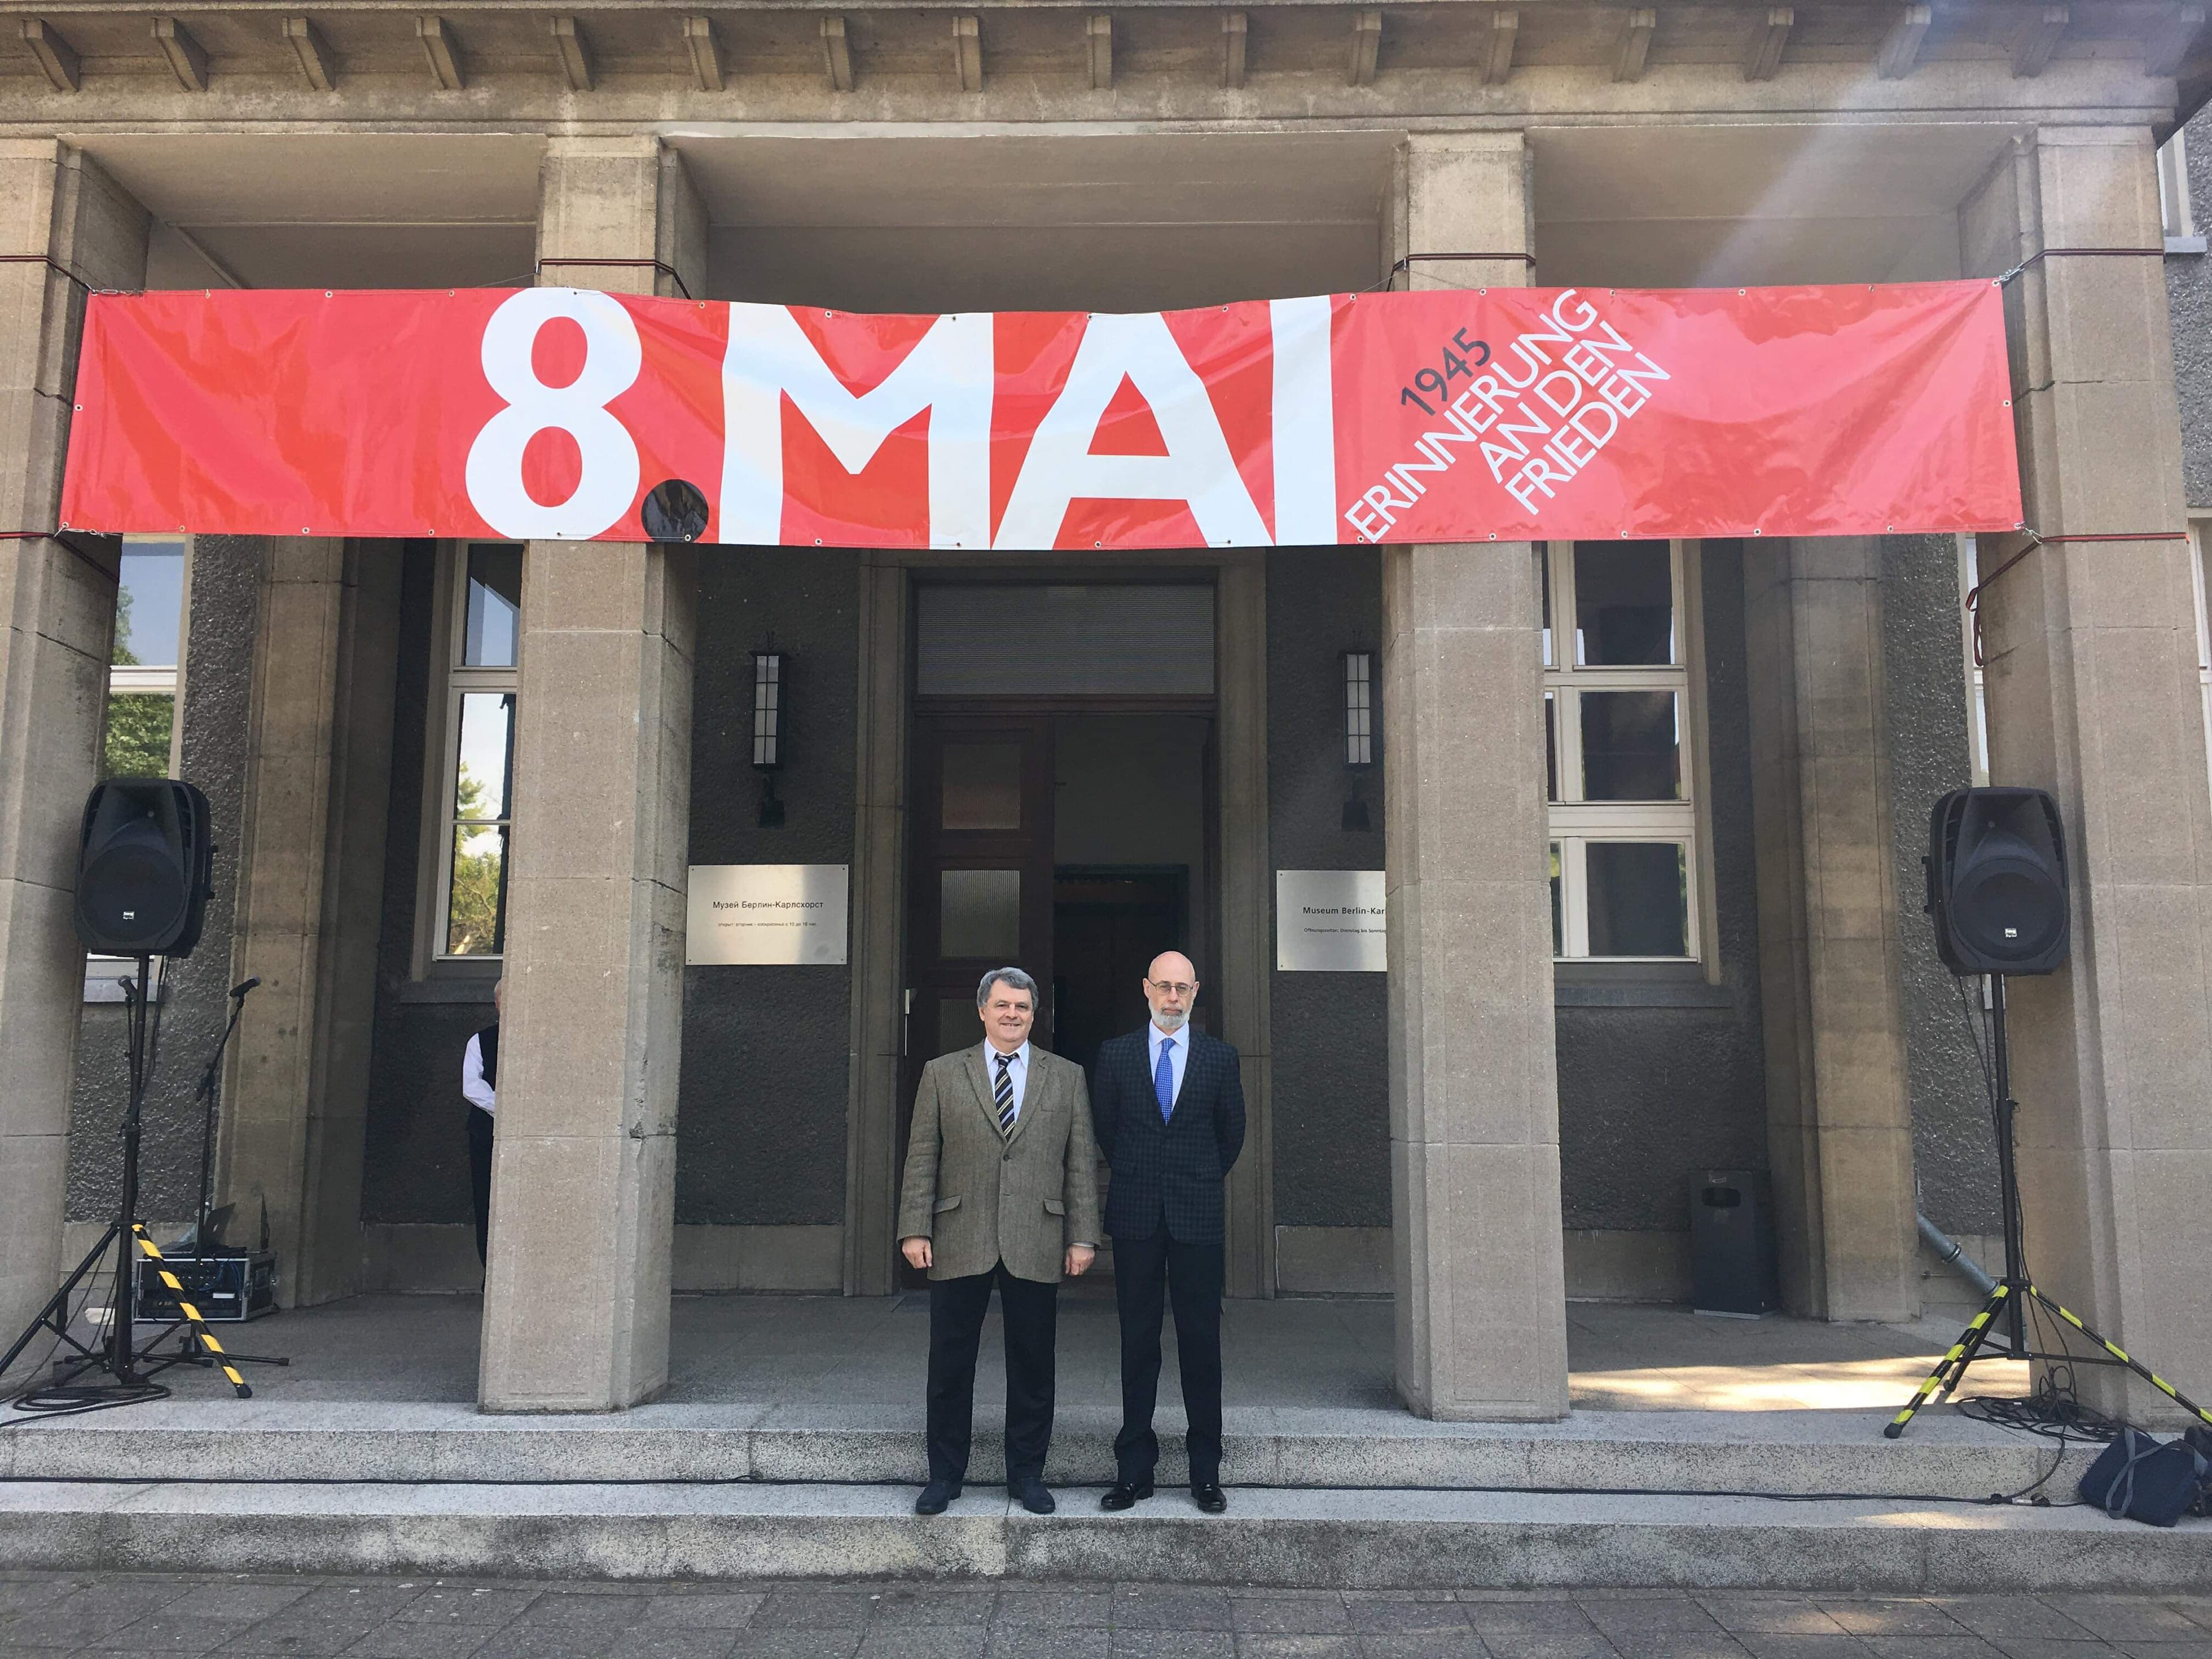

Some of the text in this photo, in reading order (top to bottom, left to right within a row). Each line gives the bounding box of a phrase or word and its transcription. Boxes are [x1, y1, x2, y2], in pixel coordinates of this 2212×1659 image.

[465, 289, 1338, 550] 8. MAI
[1344, 289, 1598, 543] ERINNERUNG
[1400, 327, 1491, 416] 1945
[1480, 320, 1633, 483] AN DEN
[1505, 352, 1671, 515] FRIEDEN
[713, 901, 824, 910] Музей Берлин-Карлсхорст
